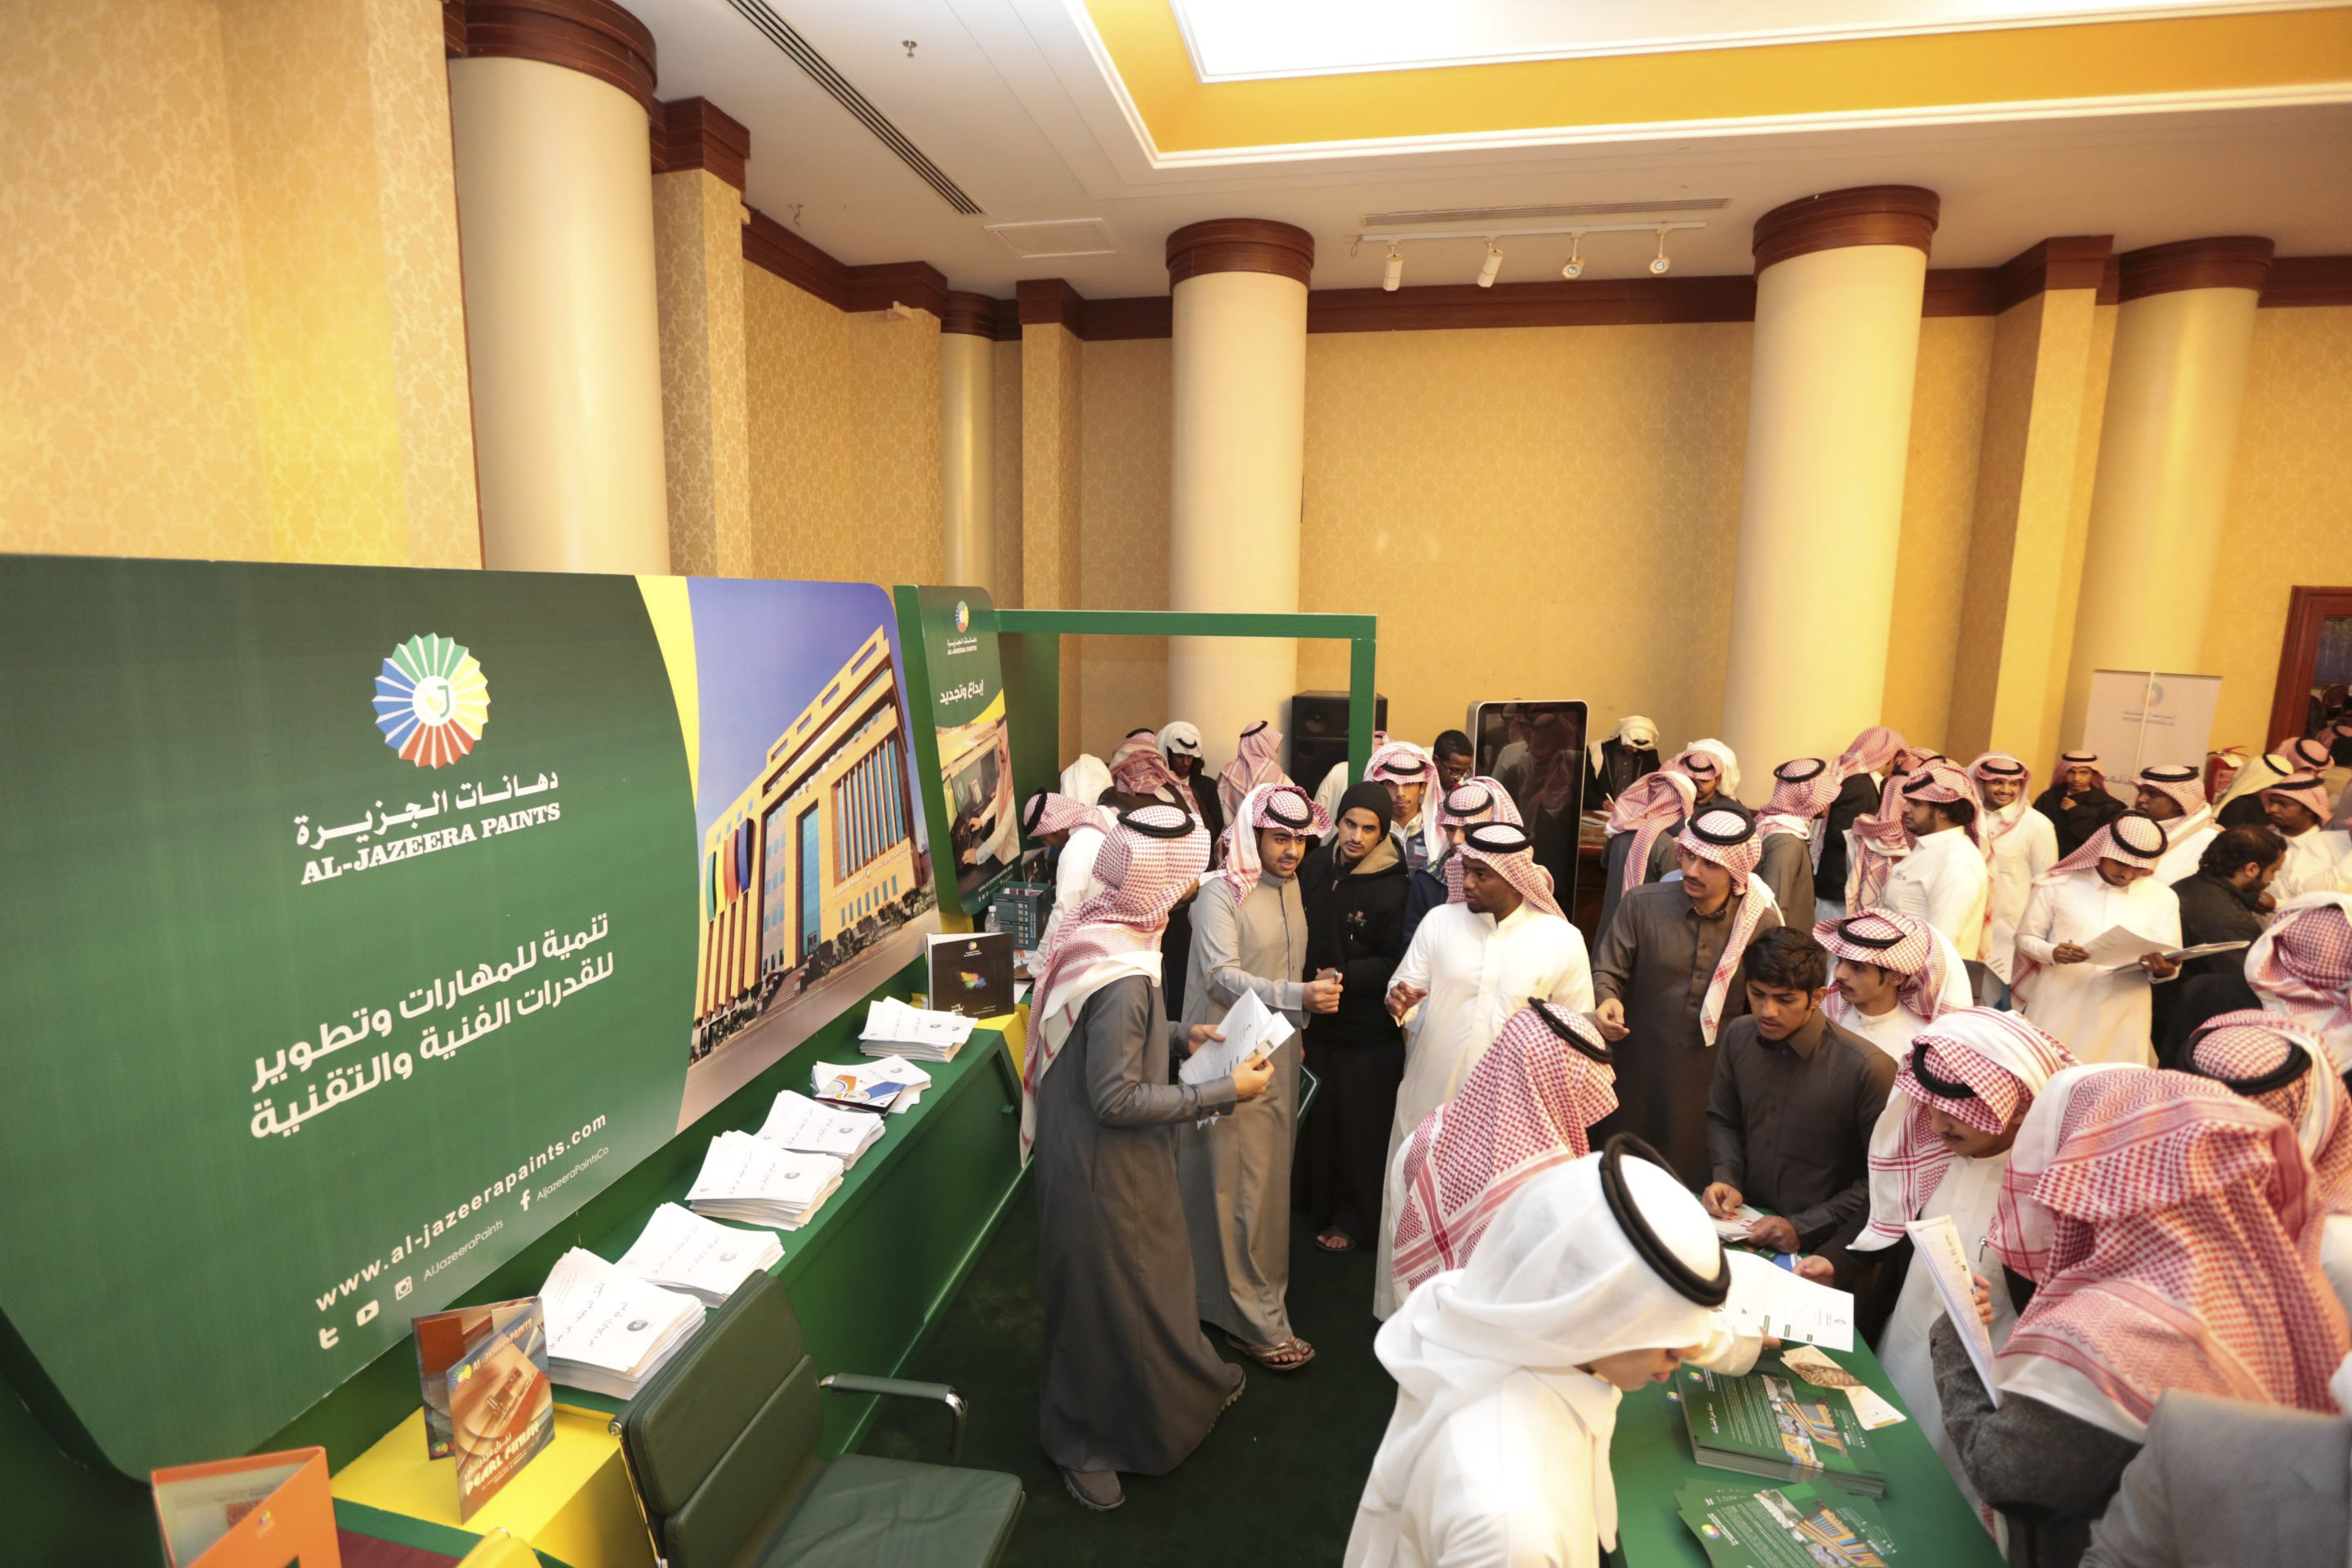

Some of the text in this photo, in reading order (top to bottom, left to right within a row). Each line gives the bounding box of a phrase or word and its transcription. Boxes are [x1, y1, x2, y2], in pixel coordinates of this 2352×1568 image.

[939, 679, 984, 706] إبداع وتجديد
[293, 771, 559, 851] دهانات الجزيرة
[300, 802, 561, 885] AL-JAZEERA PAINTS
[251, 911, 608, 1093] تنمية للمهارات وتطوير
[250, 951, 613, 1138] للقدرات الفنية والتقنية
[315, 1114, 607, 1312] www.al-jazeerapaints.com
[536, 1146, 609, 1202] AljazeeraPaintsCo
[465, 1454, 503, 1495] PEARL
[504, 1420, 539, 1460] FINISH
